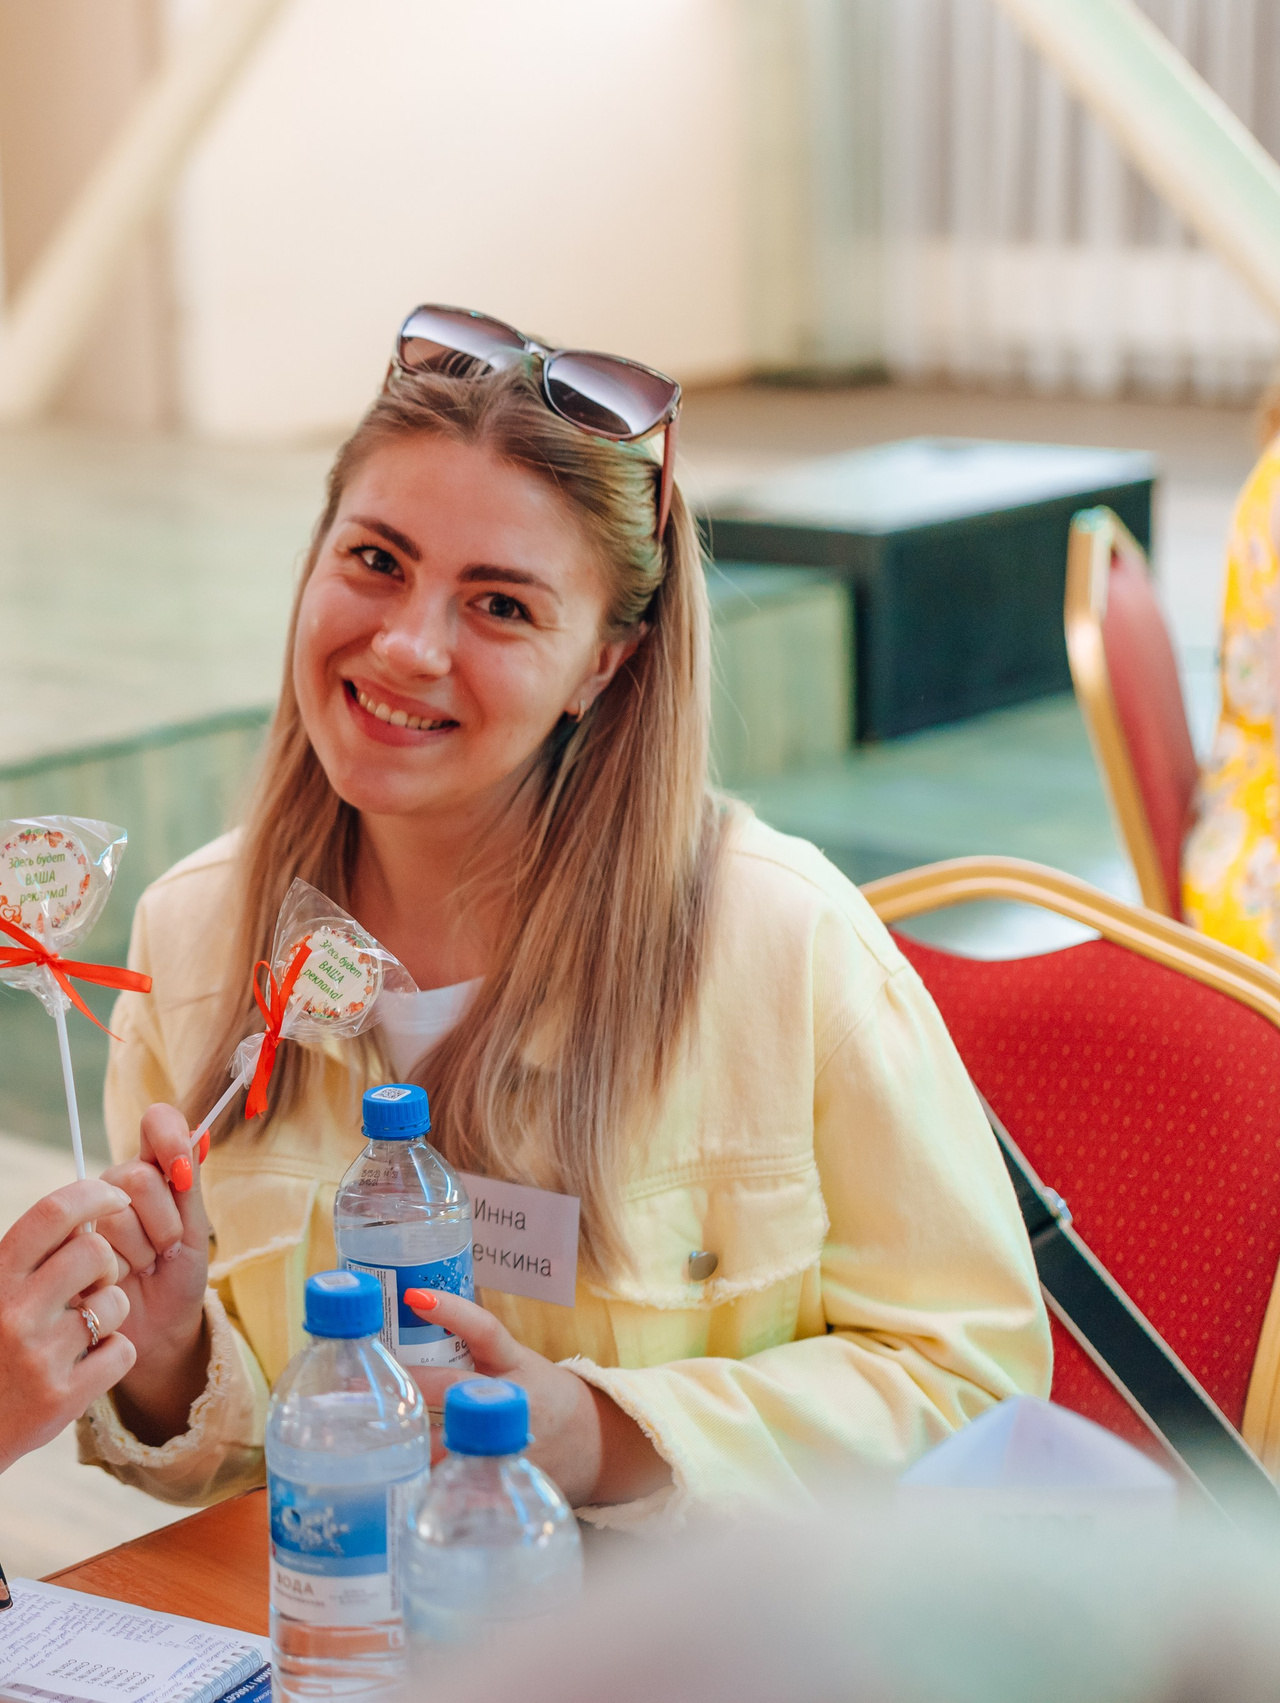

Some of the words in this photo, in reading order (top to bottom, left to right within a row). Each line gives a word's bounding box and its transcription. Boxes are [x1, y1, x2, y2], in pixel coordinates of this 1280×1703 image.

[36, 852, 66, 867] будет
[25, 870, 56, 886] ВАША
[319, 939, 340, 960] Здесь
[338, 956, 363, 979] будет
[301, 968, 344, 1000] реклама!
[318, 960, 345, 985] ВАША
[474, 1197, 526, 1231] Инна
[472, 1242, 552, 1277] ечкина
[455, 1339, 468, 1352] ВО
[223, 1684, 255, 1703] TARGET
